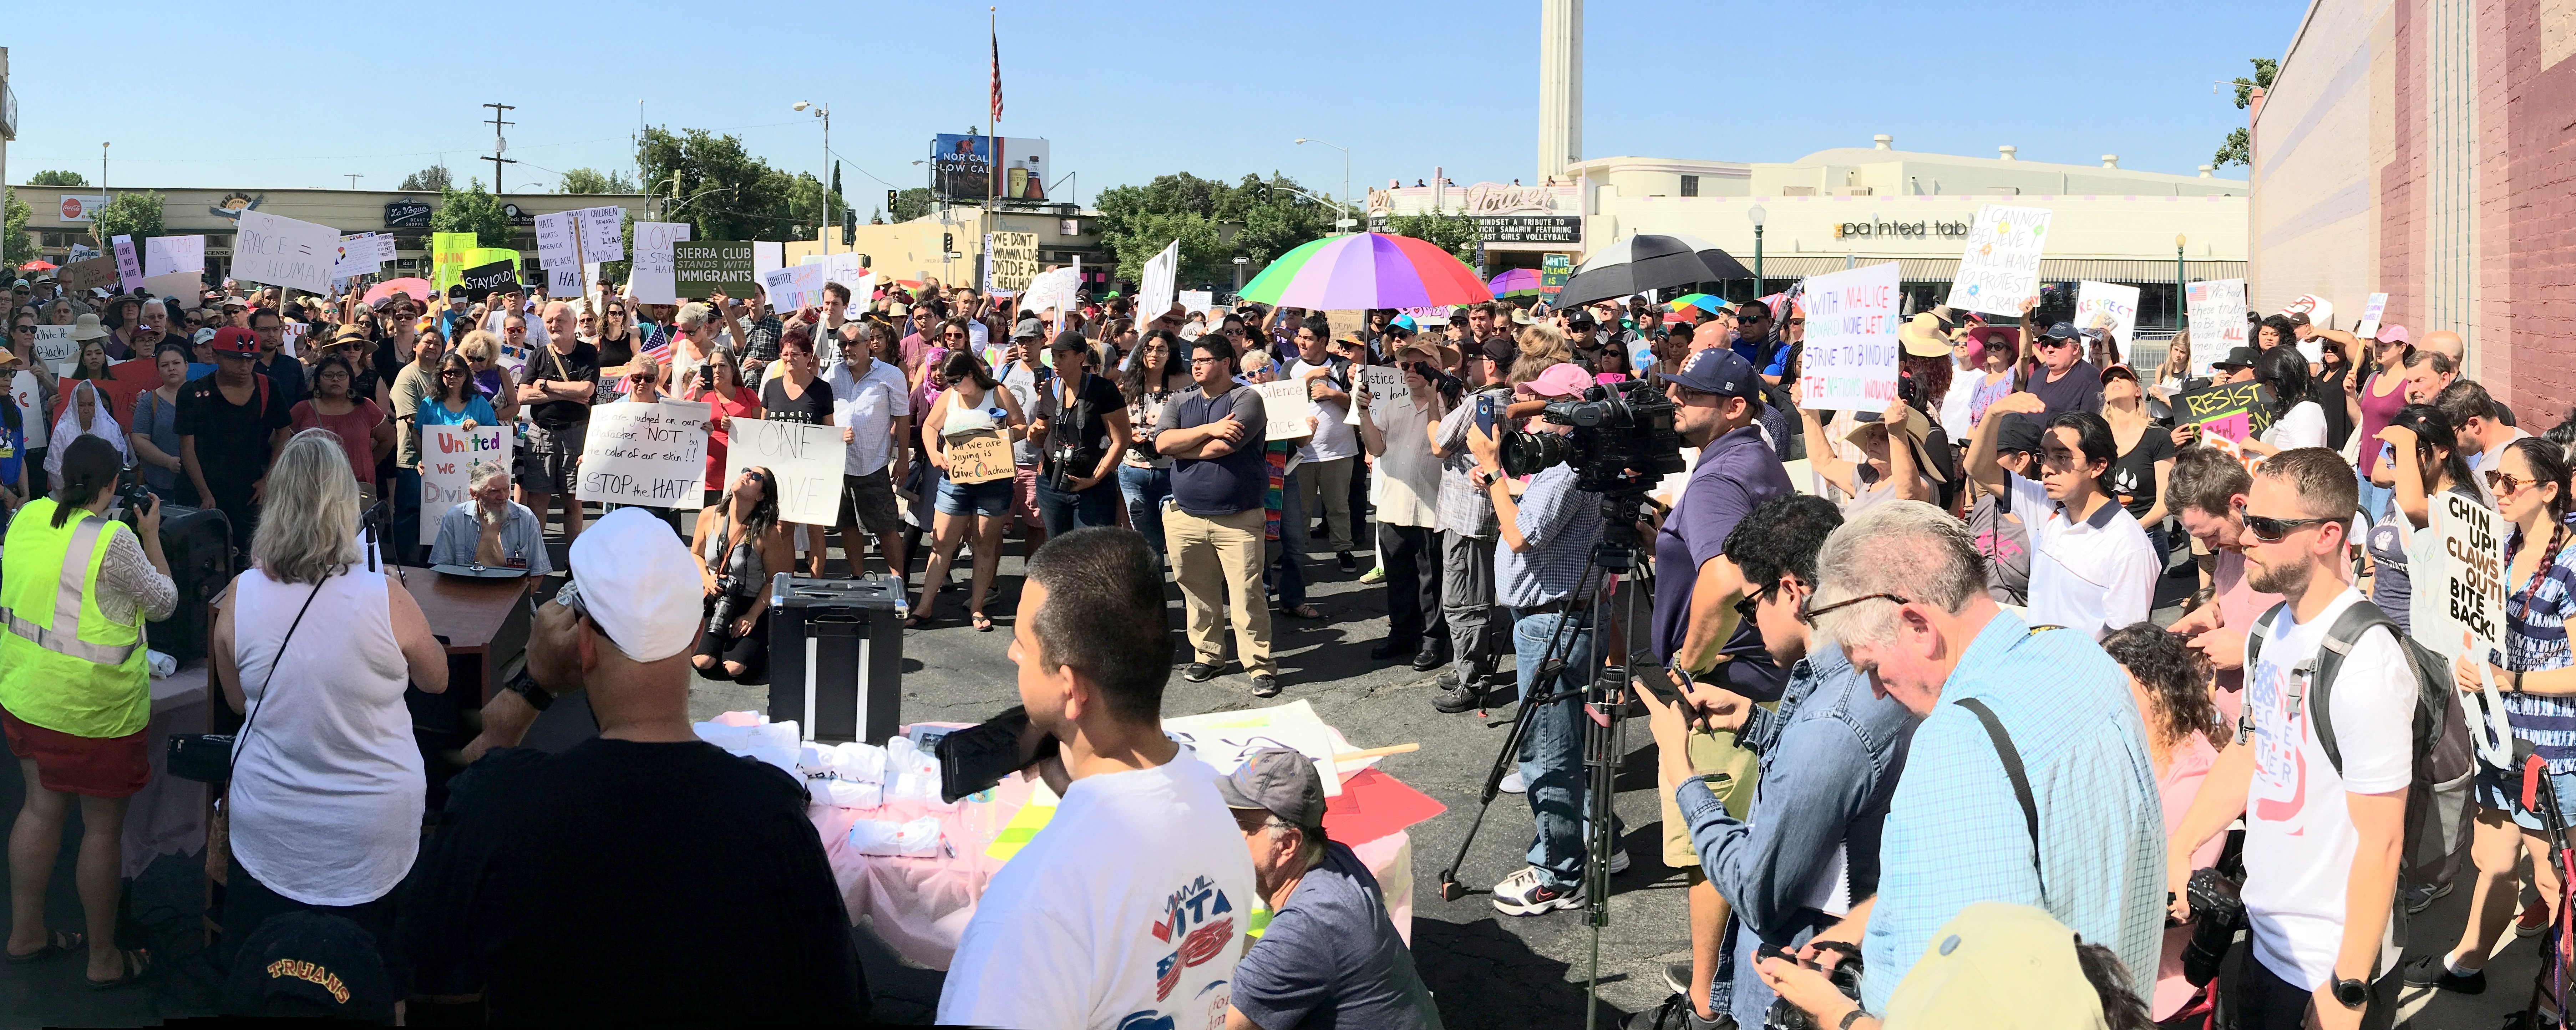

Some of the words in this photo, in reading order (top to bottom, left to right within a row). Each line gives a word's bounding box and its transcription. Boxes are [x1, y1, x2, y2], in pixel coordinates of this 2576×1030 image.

[944, 153, 965, 161] NOR
[969, 154, 988, 162] CAL
[940, 163, 965, 172] LOW
[970, 165, 989, 173] CAL
[1467, 181, 1553, 215] Tower
[391, 208, 402, 217] La
[402, 205, 429, 215] Vogue
[590, 208, 618, 218] CHILDREN
[1991, 208, 2051, 227] CANNOT
[539, 219, 555, 229] HATE
[1834, 223, 1842, 238] THE
[1842, 214, 1924, 238] painted
[242, 230, 287, 255] RACE
[433, 234, 475, 249] UNITE
[541, 231, 558, 240] HURTS
[637, 225, 689, 250] LOVE
[992, 233, 1007, 246] WE
[1011, 233, 1033, 246] DONT
[1971, 228, 2025, 248] BELIEVE
[119, 247, 131, 256] LOVE
[151, 238, 196, 253] DUMP
[677, 248, 717, 259] SIERRA
[722, 248, 751, 259] CLUB
[993, 246, 1021, 260] WANNA
[1023, 248, 1039, 262] LIVE
[1964, 248, 1999, 267] STILL
[2005, 253, 2038, 271] HAVE
[123, 257, 134, 266] NOT
[160, 254, 202, 271] TRUMP
[543, 256, 572, 268] IMPEACH
[677, 260, 718, 269] STANDS
[723, 260, 751, 269] WITH
[992, 260, 1023, 276] INSIDE
[1028, 263, 1037, 276] A
[1545, 257, 1569, 266] WHITE
[125, 268, 137, 278] HATE
[267, 259, 332, 287] HUMAN
[678, 270, 751, 282] IMMIGRANTS
[825, 258, 858, 282] Unite
[1052, 270, 1075, 279] COMES
[1543, 266, 1568, 275] SILENCE
[1042, 280, 1076, 294] SILENCE
[1959, 268, 1976, 284] TO
[1979, 271, 2033, 293] PROTEST
[1845, 285, 1889, 310] MALICE
[1951, 289, 1980, 309] THIS
[2210, 284, 2223, 299] We
[2226, 285, 2243, 299] hold
[2079, 299, 2133, 318] RESPECT
[2192, 303, 2215, 318] these
[2219, 300, 2246, 315] truths
[1806, 320, 1840, 338] TOWARD
[1843, 316, 1862, 335] NONE
[1866, 315, 1883, 335] LET
[1885, 314, 1895, 334] US
[2192, 319, 2202, 329] to
[35, 328, 57, 341] White
[2223, 327, 2243, 340] ALL
[37, 344, 65, 358] Black
[2194, 343, 2212, 352] men
[2216, 342, 2231, 350] are
[1805, 347, 1837, 369] STRIVE
[1843, 346, 1854, 366] TO
[1858, 344, 1881, 367] BIND
[1884, 346, 1895, 367] UP
[597, 385, 616, 393] FREE
[1261, 385, 1303, 399] Silence
[1804, 376, 1825, 399] THE
[2186, 383, 2262, 417] RESIST
[629, 411, 659, 429] judged
[770, 410, 812, 420] nasty
[438, 431, 500, 454] United
[648, 427, 683, 443] NOT
[689, 433, 698, 452] by
[759, 422, 822, 460] ONE
[952, 441, 964, 450] All
[605, 445, 627, 458] color
[627, 448, 640, 459] of
[436, 463, 455, 474] we
[952, 464, 974, 479] Give
[584, 472, 633, 495] STOP
[632, 483, 650, 497] the
[653, 478, 702, 500] HATE
[2449, 496, 2490, 534] CHIN
[2469, 526, 2496, 558] UP!
[2446, 536, 2499, 580] CLAWS
[2450, 576, 2484, 615] BITE
[2466, 567, 2502, 611] OUT!
[2450, 598, 2495, 643] BACK!
